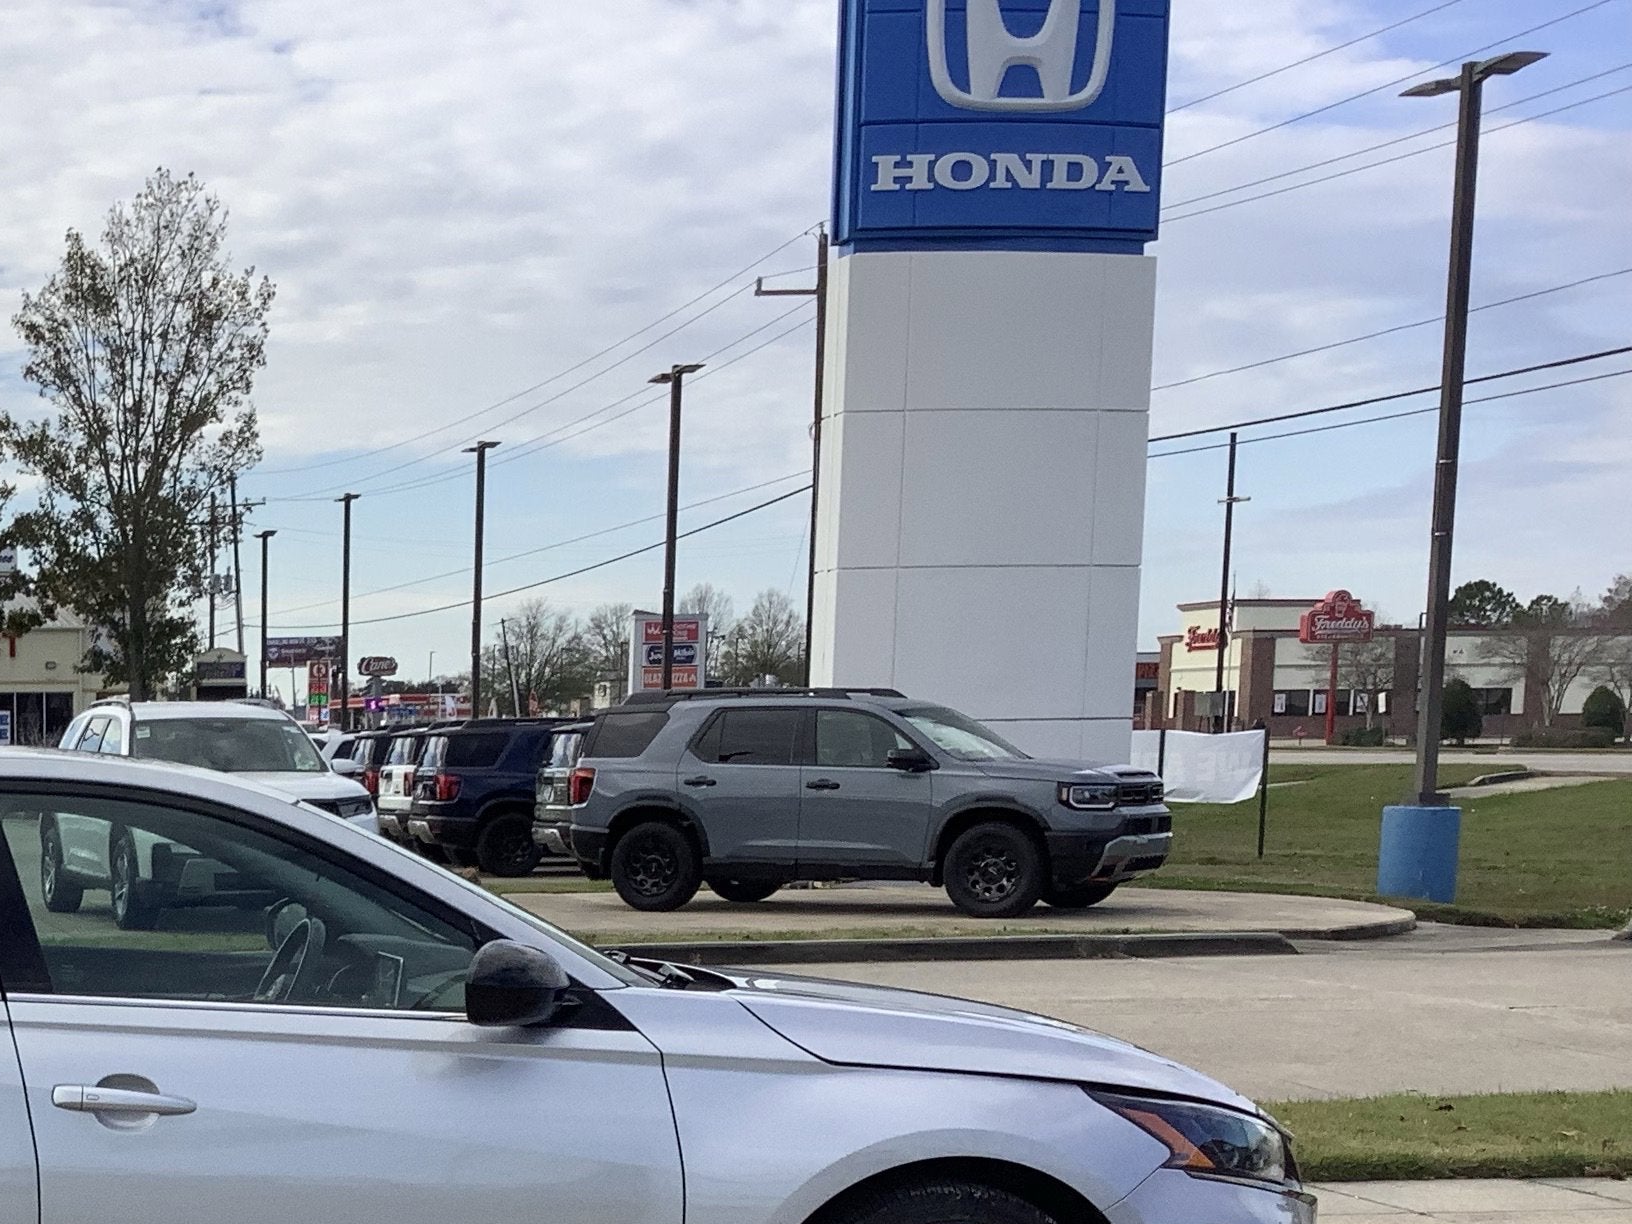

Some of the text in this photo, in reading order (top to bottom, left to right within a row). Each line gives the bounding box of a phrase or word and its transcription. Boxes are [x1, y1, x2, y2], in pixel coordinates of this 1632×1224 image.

[870, 152, 1151, 193] HONDA
[1312, 615, 1369, 632] Freddy's
[1185, 626, 1226, 652] Fredd
[361, 657, 396, 675] Cane's
[644, 672, 688, 684] BLAZ IZZA
